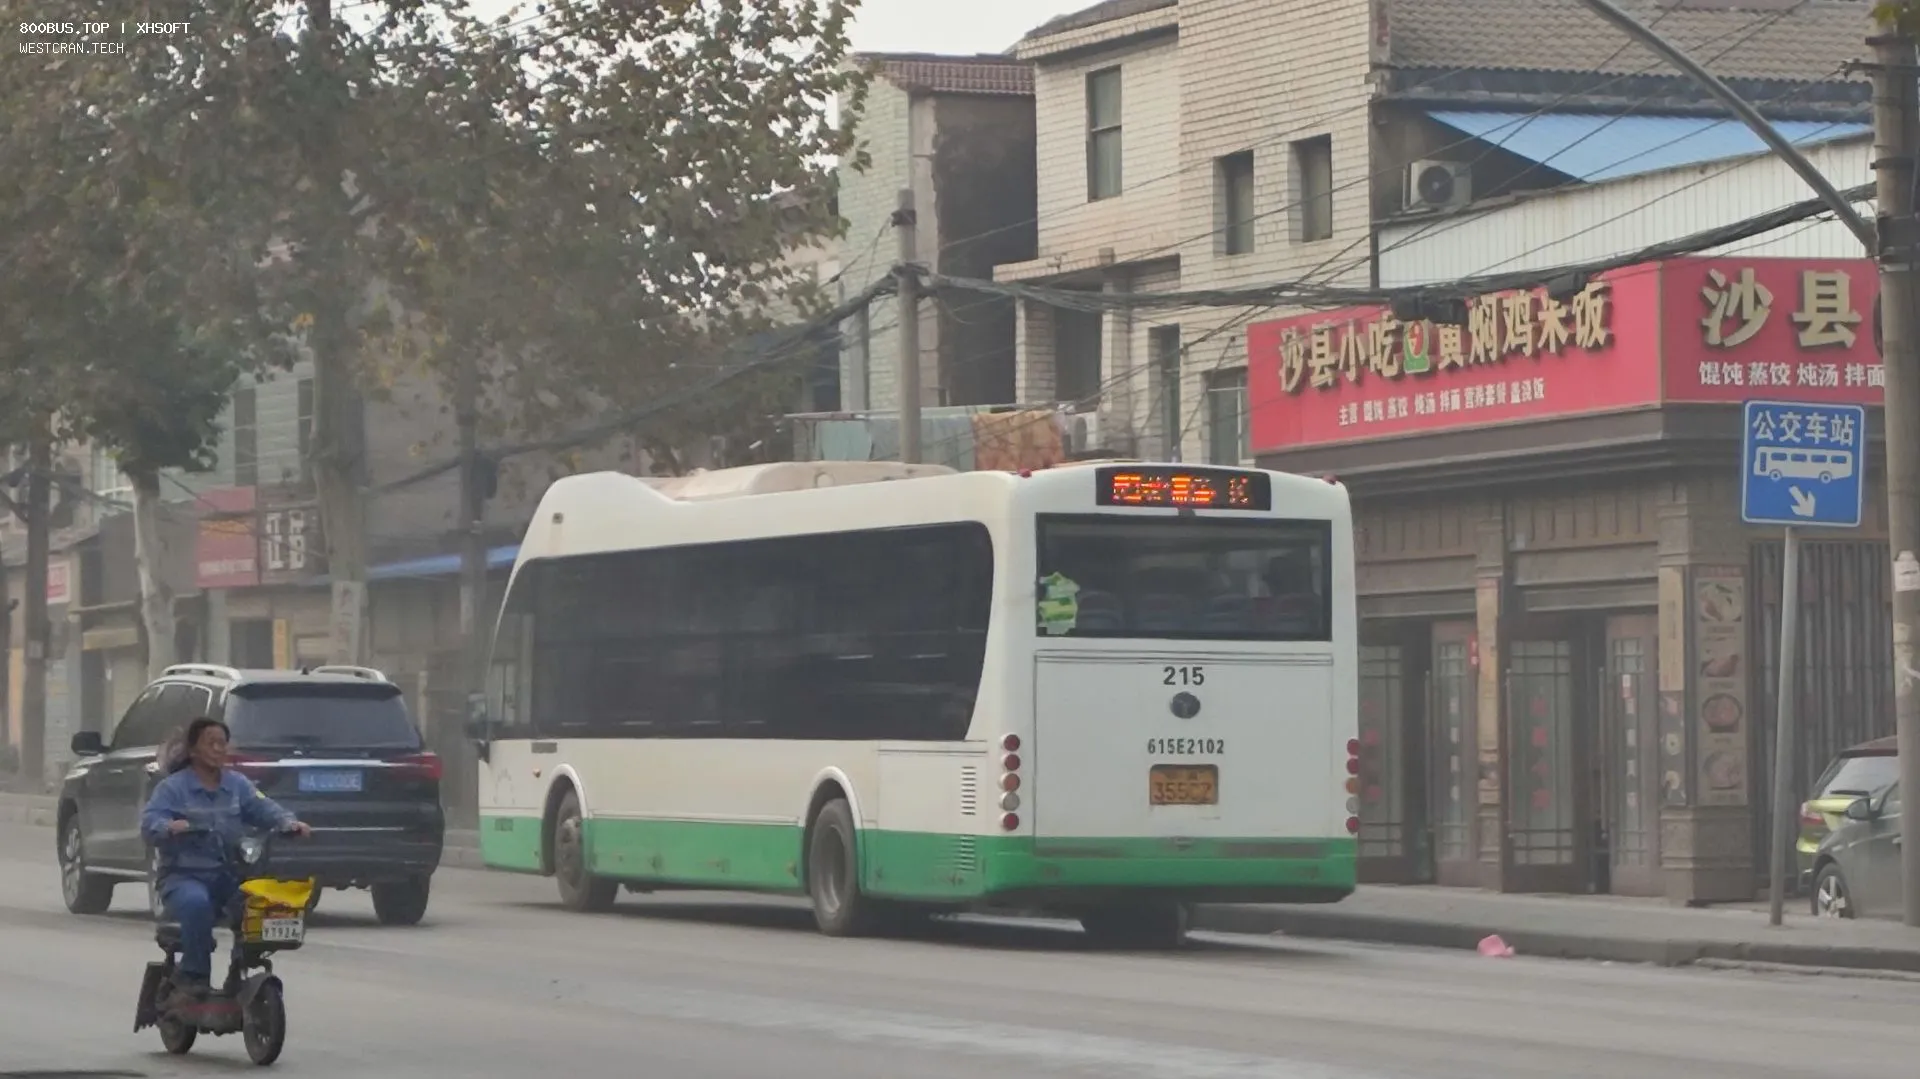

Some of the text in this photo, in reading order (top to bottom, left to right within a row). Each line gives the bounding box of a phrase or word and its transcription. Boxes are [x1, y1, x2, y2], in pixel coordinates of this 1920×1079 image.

[1701, 267, 1862, 348] 沙县
[1279, 310, 1400, 392] 沙县小吃
[1699, 361, 1885, 388] 馄饨 蒸饺 炖汤 拌面
[1752, 411, 1855, 446] 公交车站
[1163, 666, 1205, 686] 215
[1147, 738, 1225, 754] 615E2102
